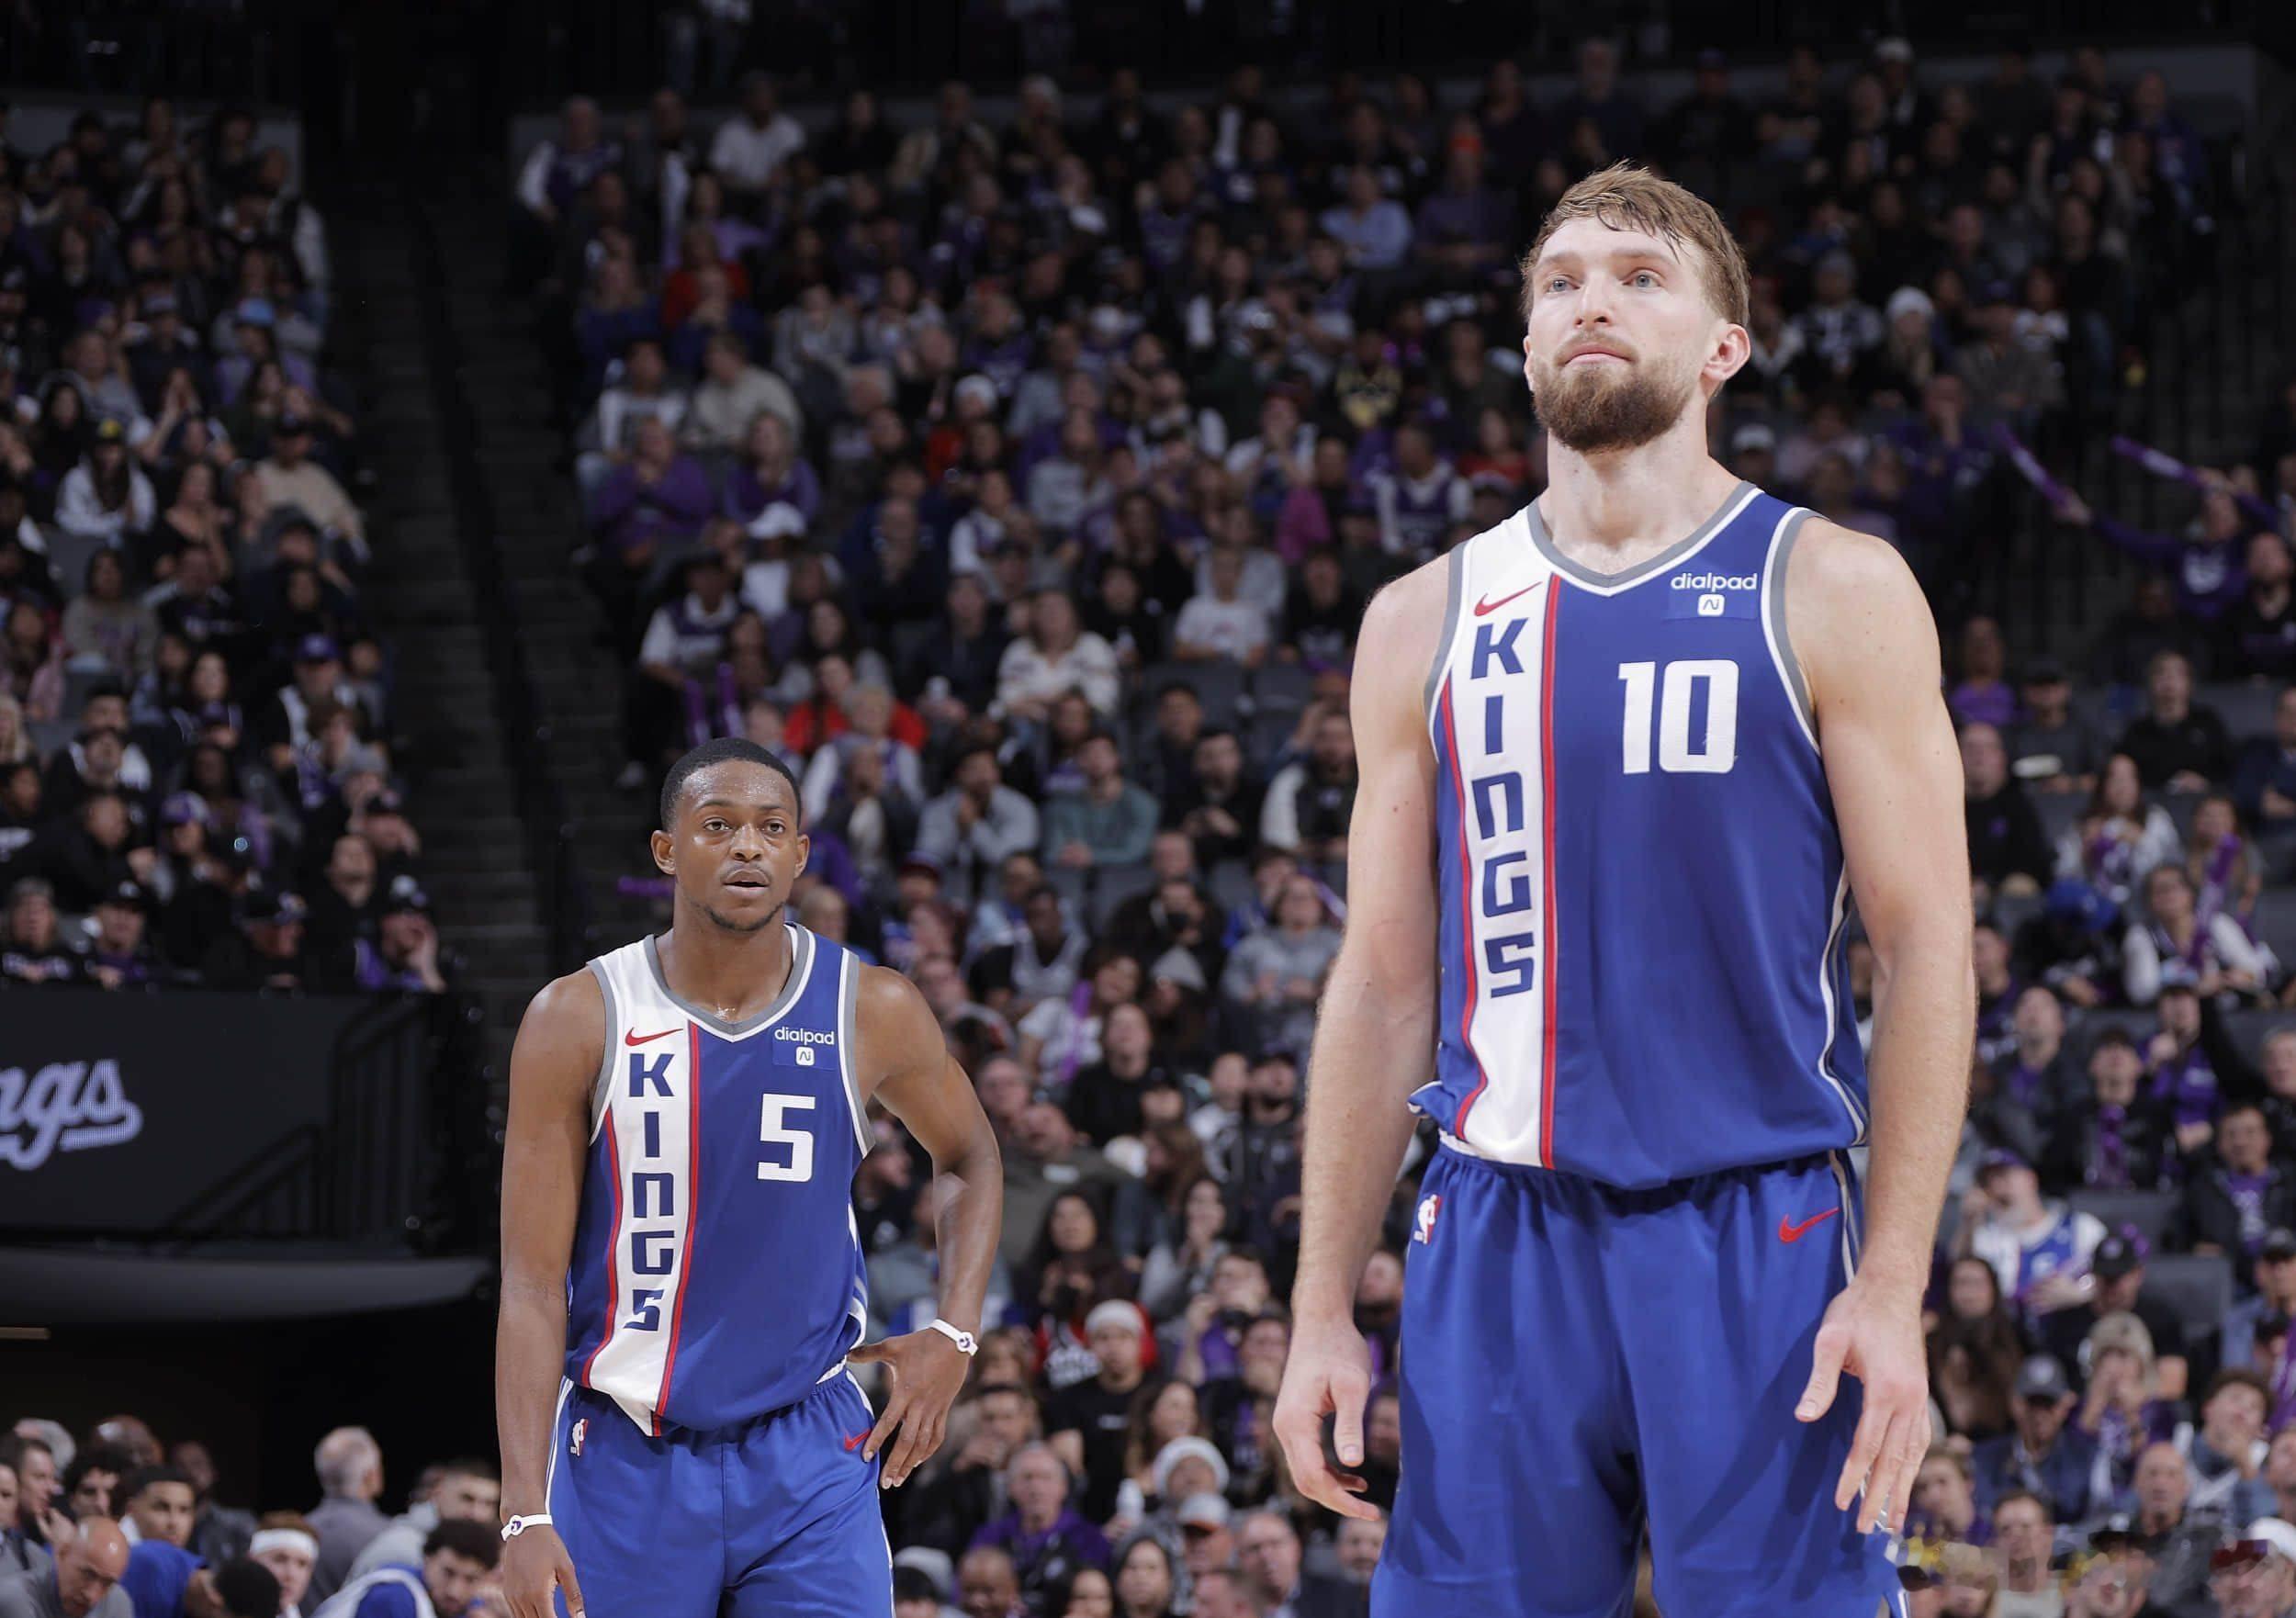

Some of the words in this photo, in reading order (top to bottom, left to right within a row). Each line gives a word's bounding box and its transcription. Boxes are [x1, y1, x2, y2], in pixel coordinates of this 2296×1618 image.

[1671, 572, 1758, 593] dialpad
[1618, 659, 1739, 774] 10
[1470, 617, 1535, 999] KINGS
[774, 1026, 835, 1046] dialpad
[758, 1094, 816, 1182] 5
[624, 1052, 675, 1331] KINGS
